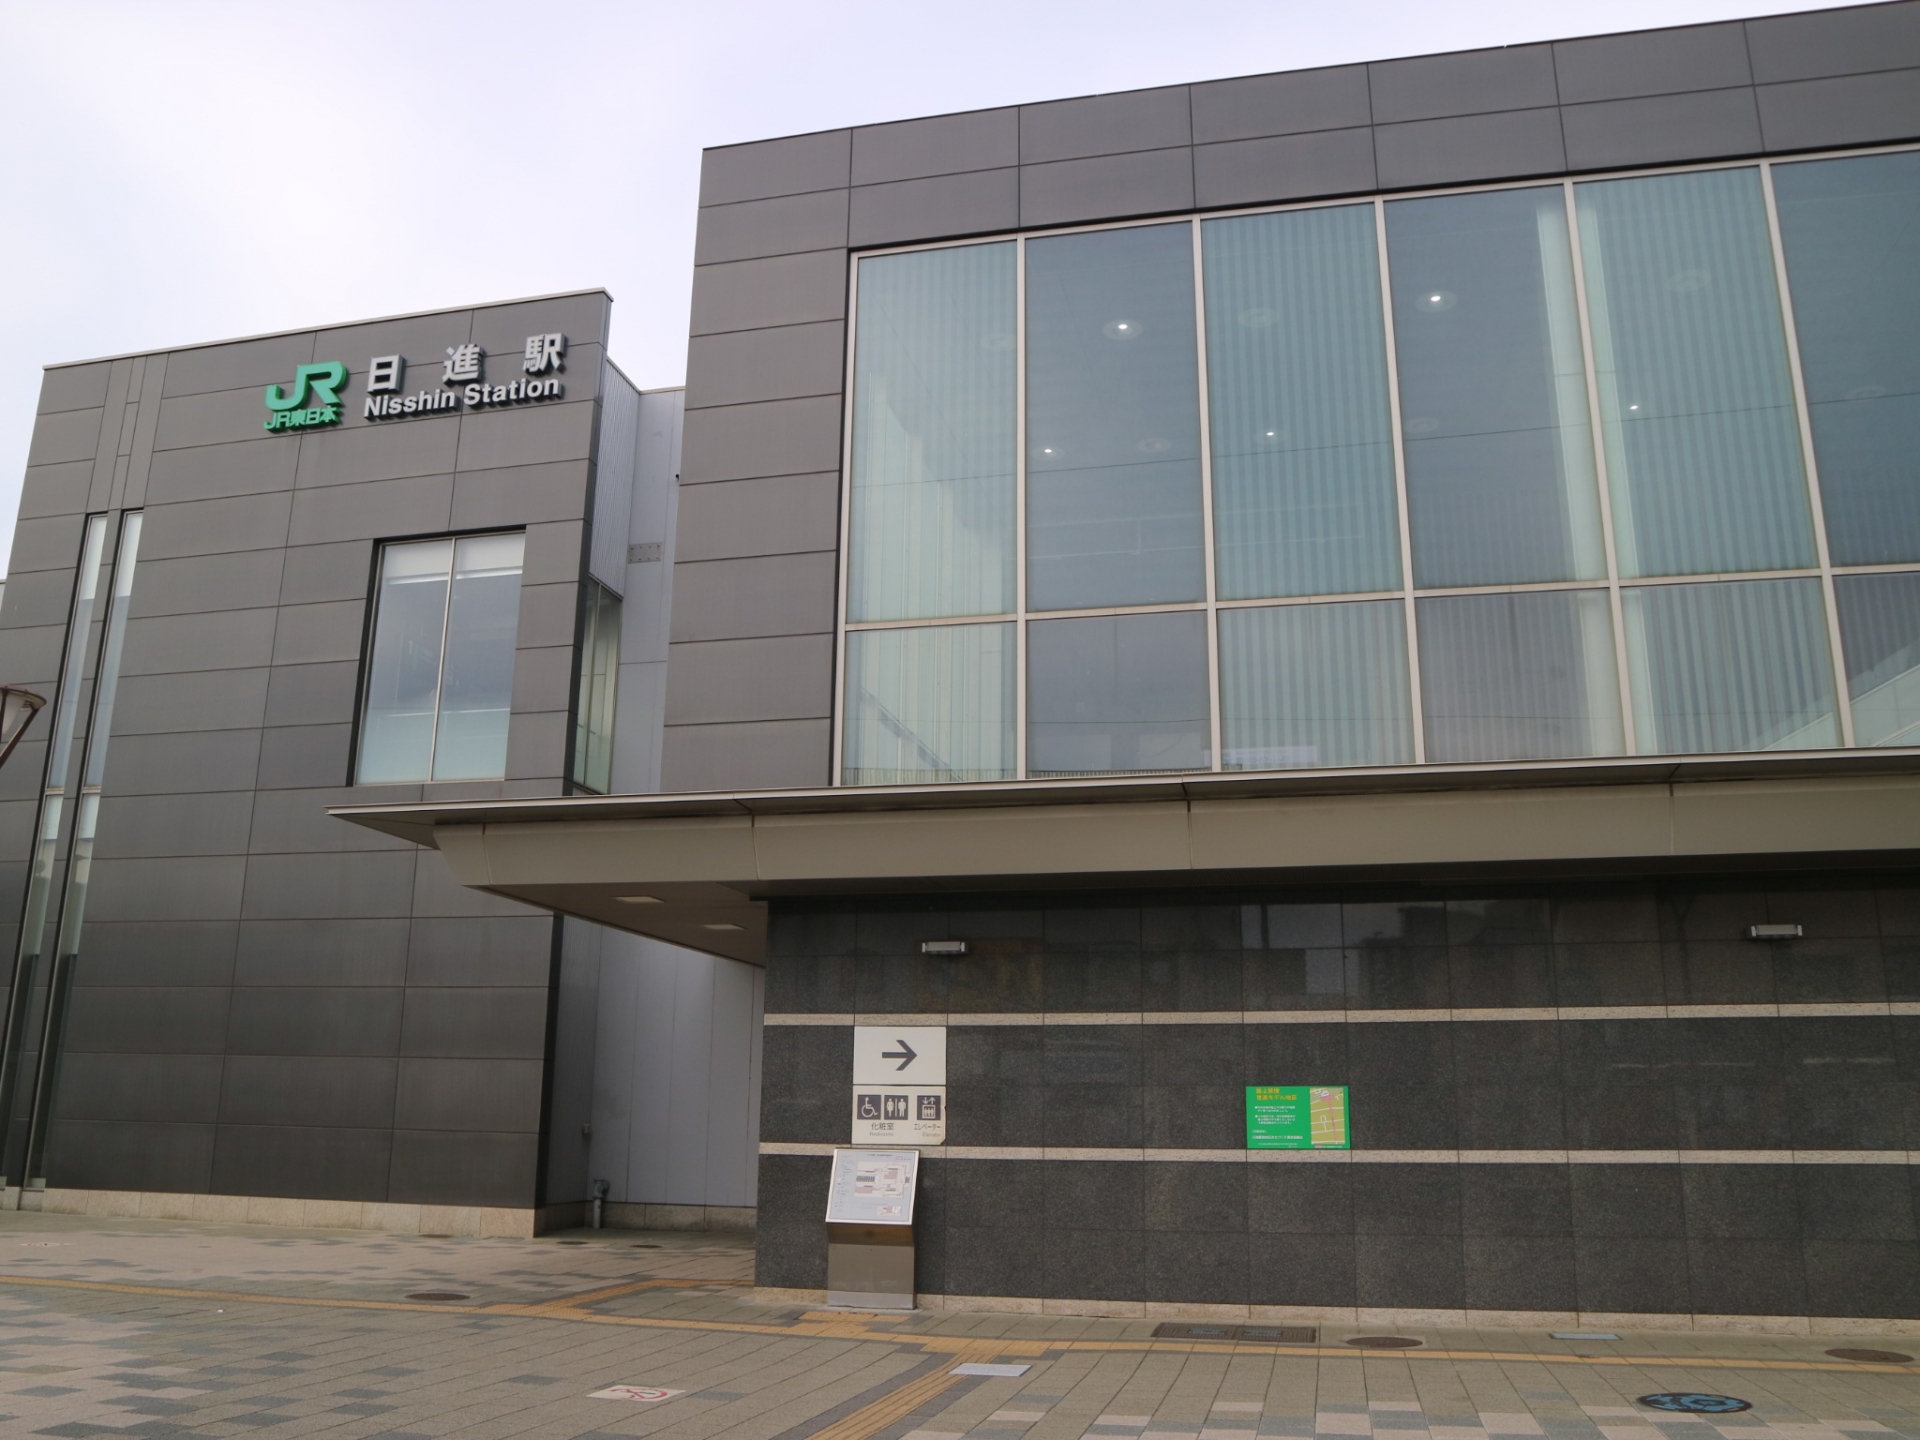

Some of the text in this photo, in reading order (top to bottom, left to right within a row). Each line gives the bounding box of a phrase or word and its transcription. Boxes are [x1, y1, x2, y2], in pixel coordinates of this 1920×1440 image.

[367, 332, 565, 393] 日進駅
[265, 360, 348, 411] JR
[364, 378, 560, 419] Nisshin Station
[263, 405, 338, 430] JR東日本
[871, 1122, 894, 1131] 化粧室
[913, 1123, 941, 1131] エレベーター
